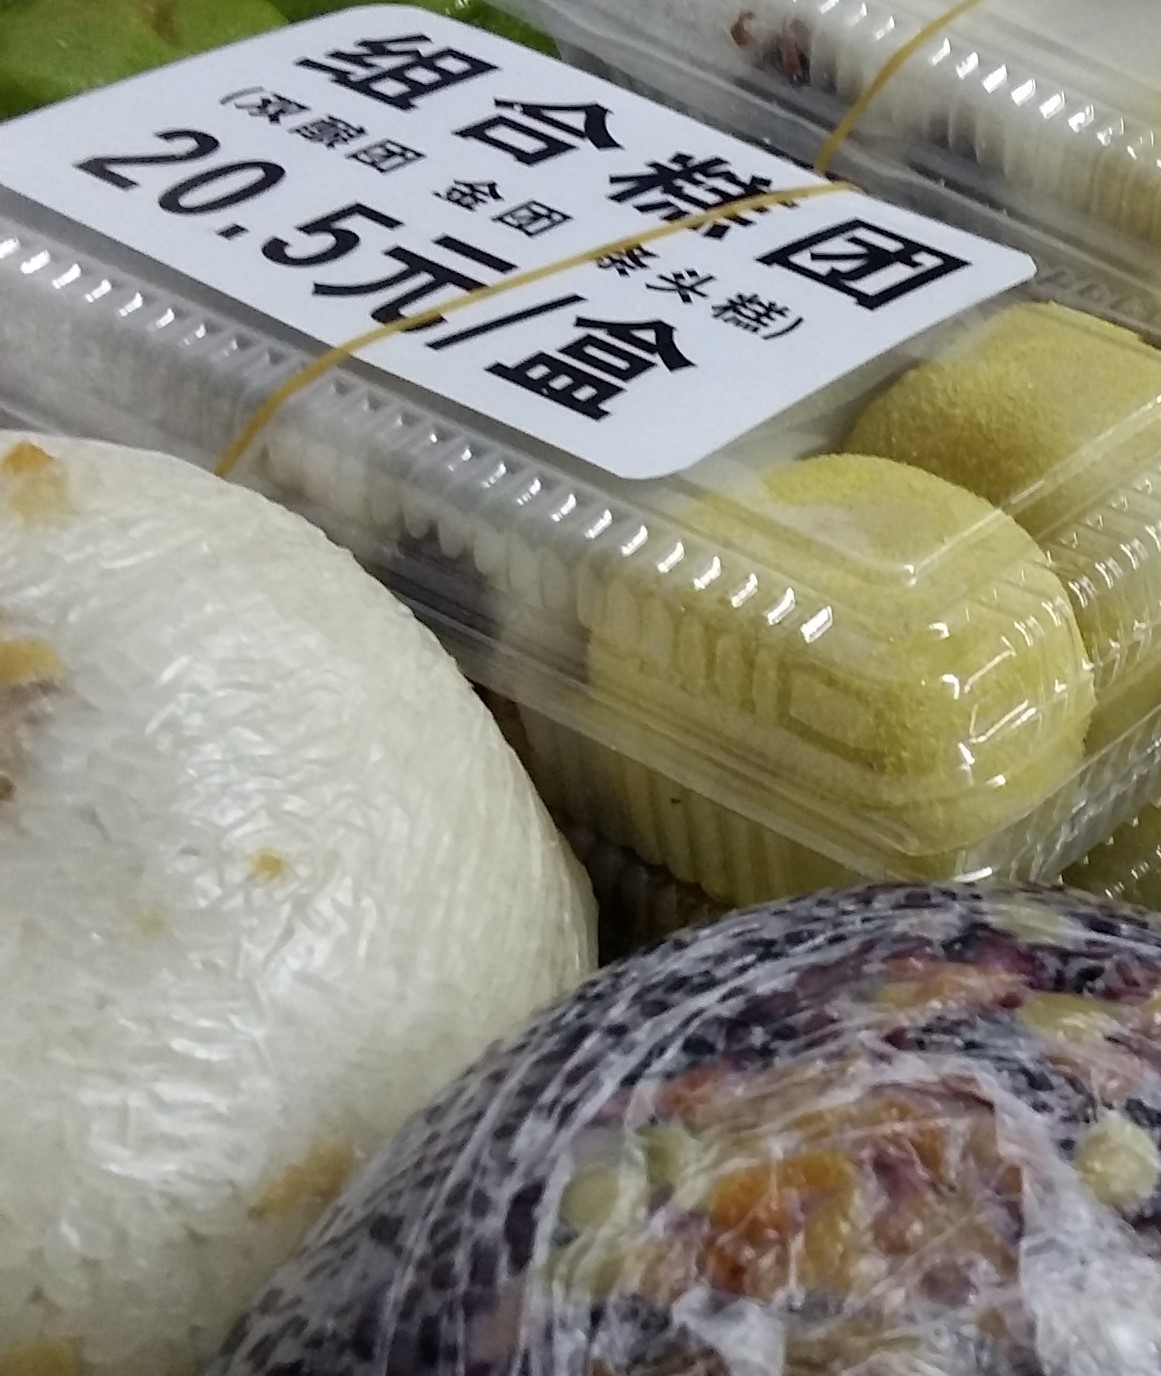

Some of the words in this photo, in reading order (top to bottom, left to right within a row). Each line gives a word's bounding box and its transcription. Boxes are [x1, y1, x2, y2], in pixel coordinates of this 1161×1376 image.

[73, 127, 697, 421] 20.5元/盒
[296, 32, 973, 315] 组合糕团
[434, 178, 574, 238] 金团
